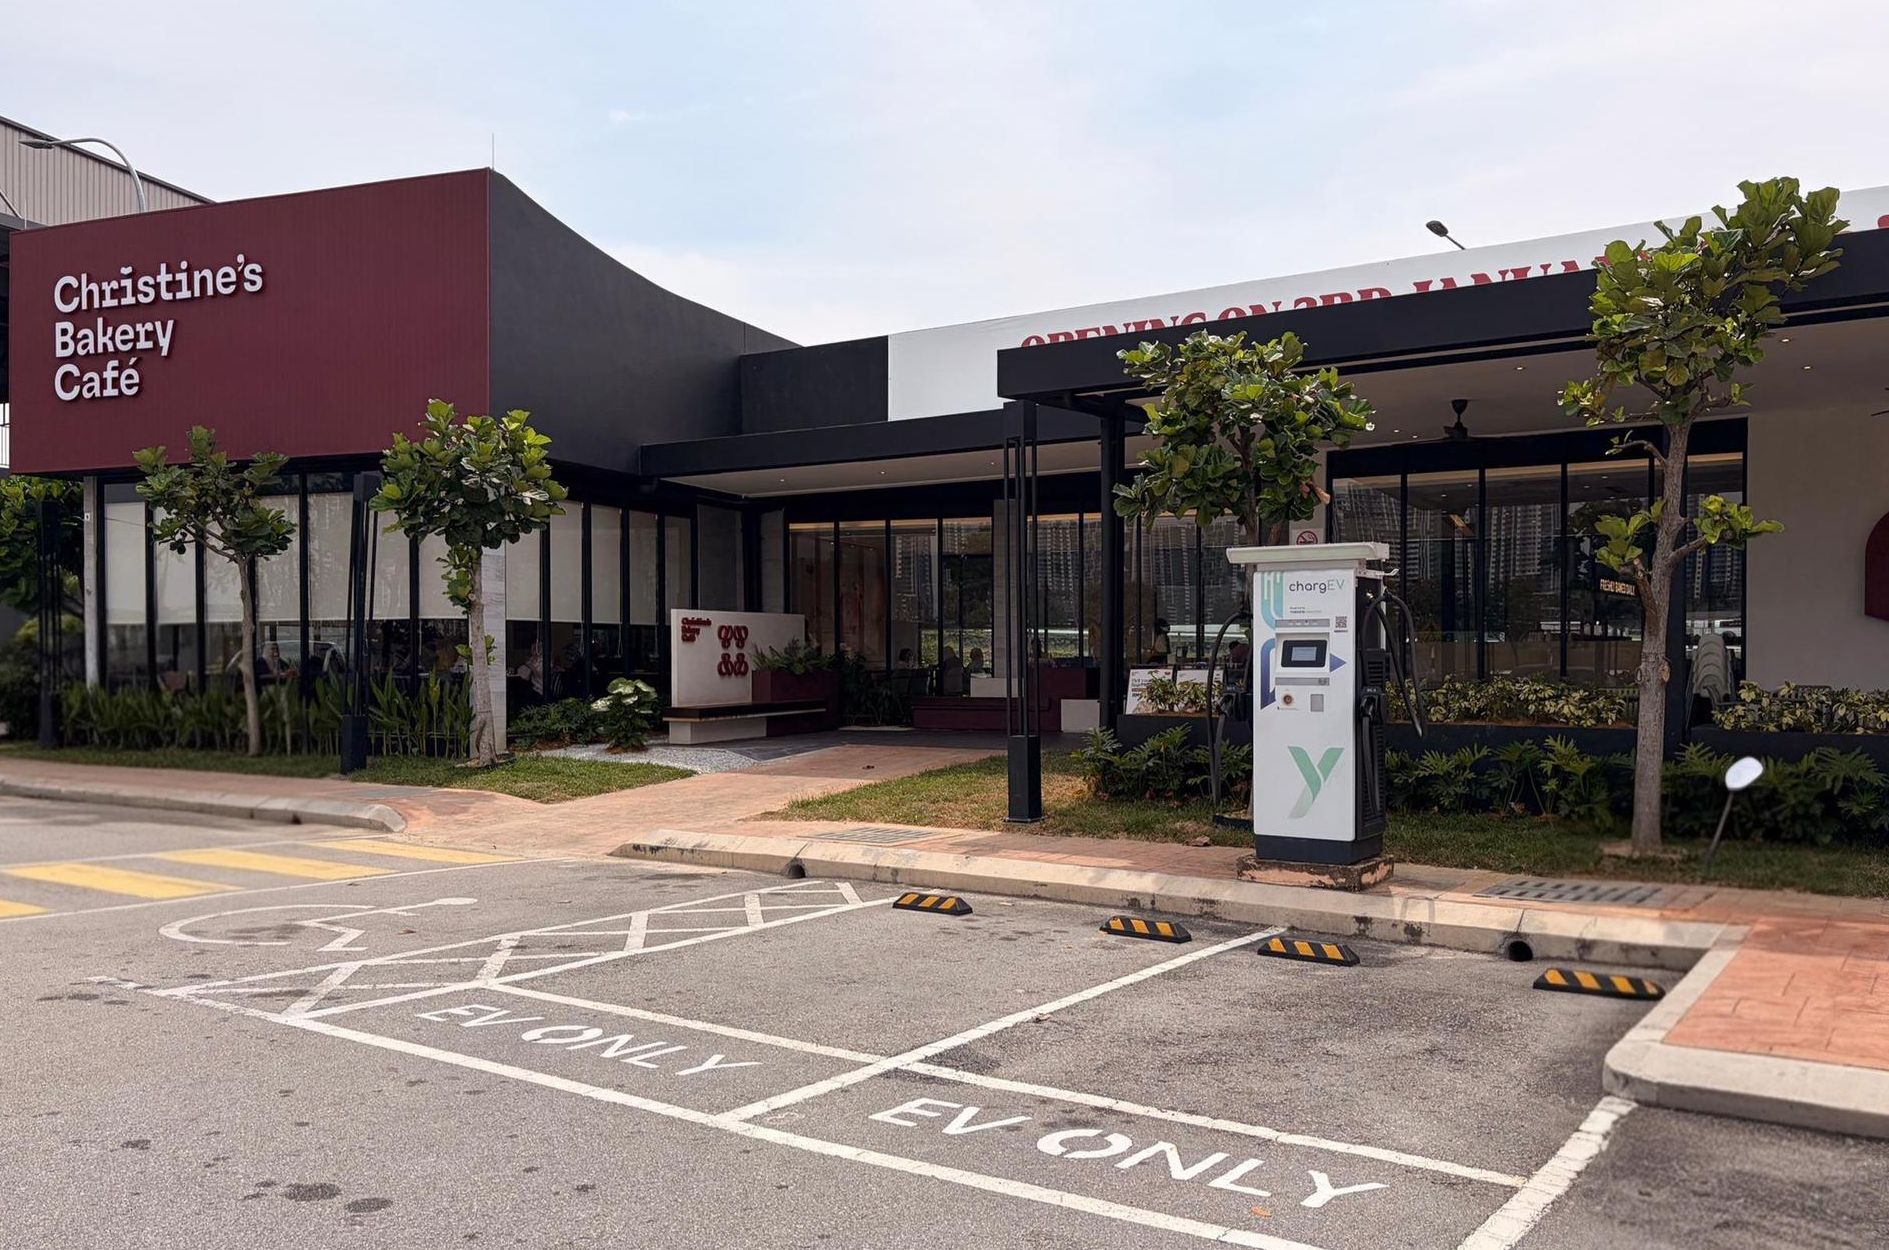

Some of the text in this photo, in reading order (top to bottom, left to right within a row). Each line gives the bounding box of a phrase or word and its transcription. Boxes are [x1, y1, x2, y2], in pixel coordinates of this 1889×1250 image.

[54, 253, 264, 313] Christine's
[55, 317, 175, 357] Bakery
[54, 356, 140, 401] Café
[1288, 579, 1345, 594] chargEV
[415, 1004, 763, 1076] EV ONLY
[867, 1098, 1390, 1208] EV ONLY
